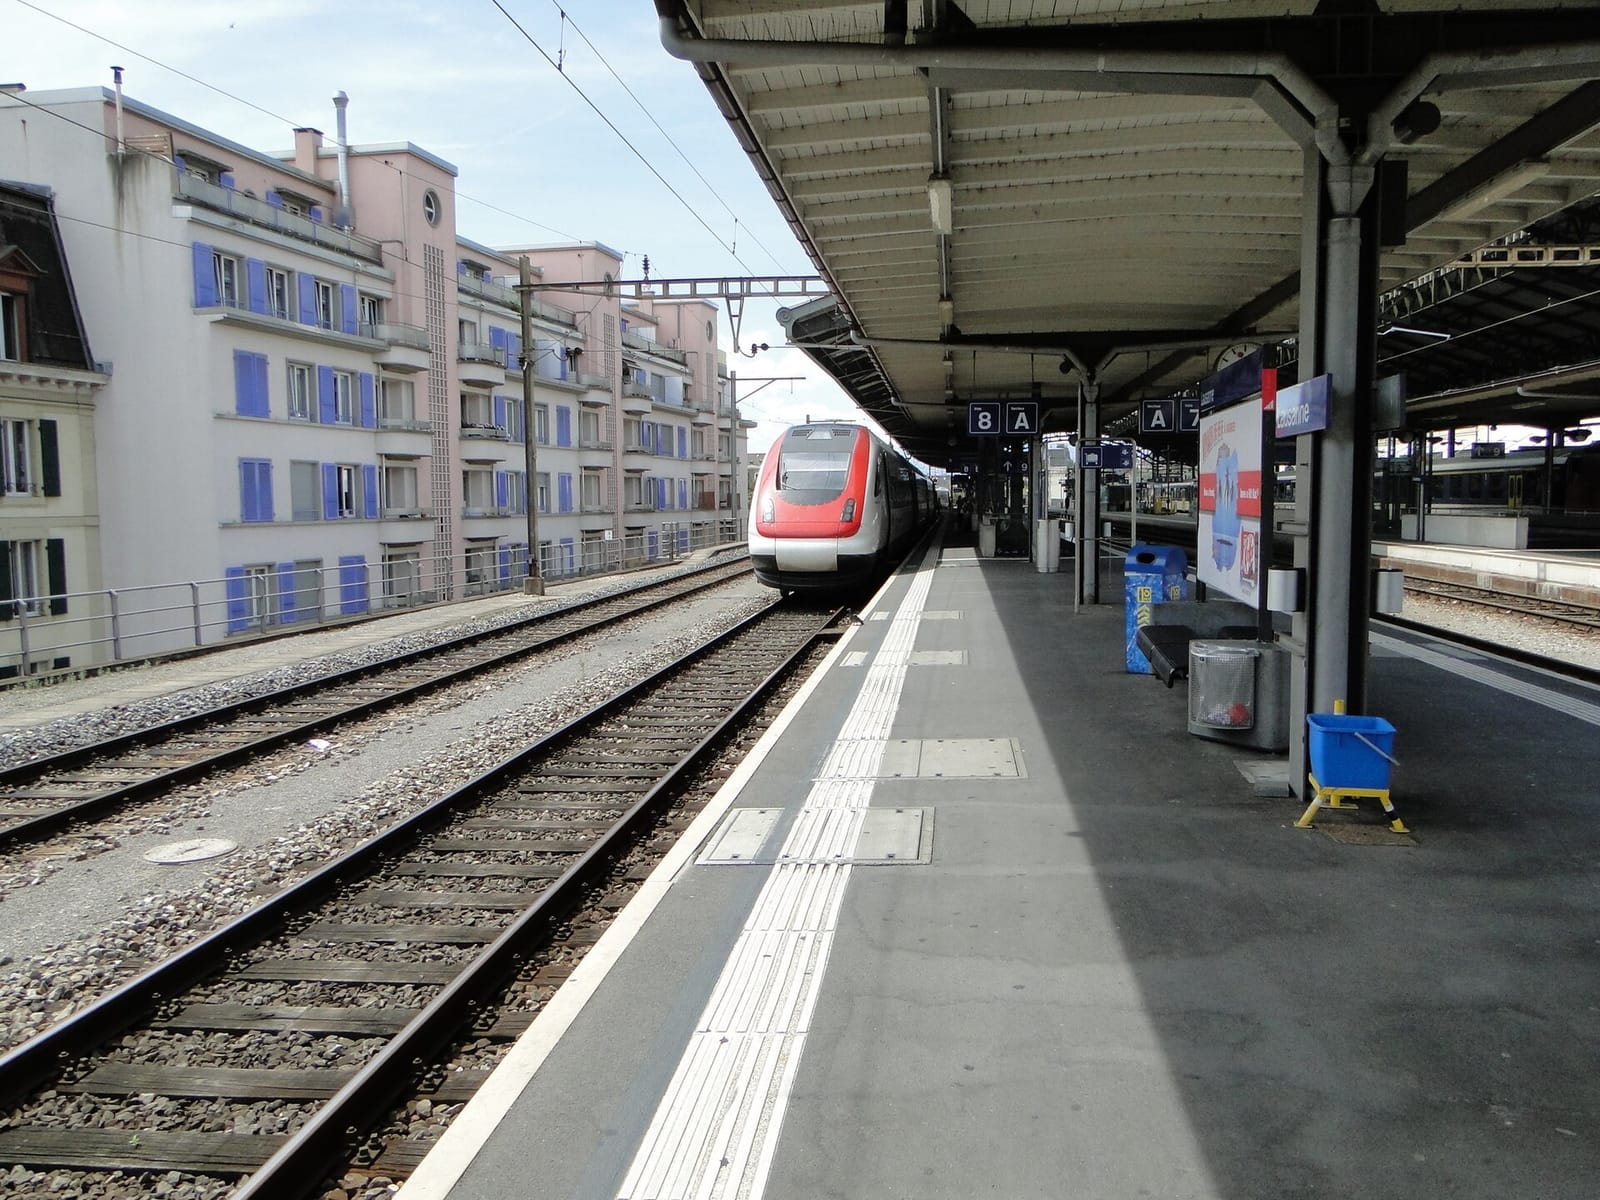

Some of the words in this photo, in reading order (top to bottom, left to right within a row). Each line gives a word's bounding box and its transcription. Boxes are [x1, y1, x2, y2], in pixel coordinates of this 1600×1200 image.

[978, 411, 992, 430] 8
[1014, 412, 1030, 430] A
[1150, 409, 1166, 428] A
[1189, 408, 1200, 427] 7
[1021, 462, 1028, 471] 9
